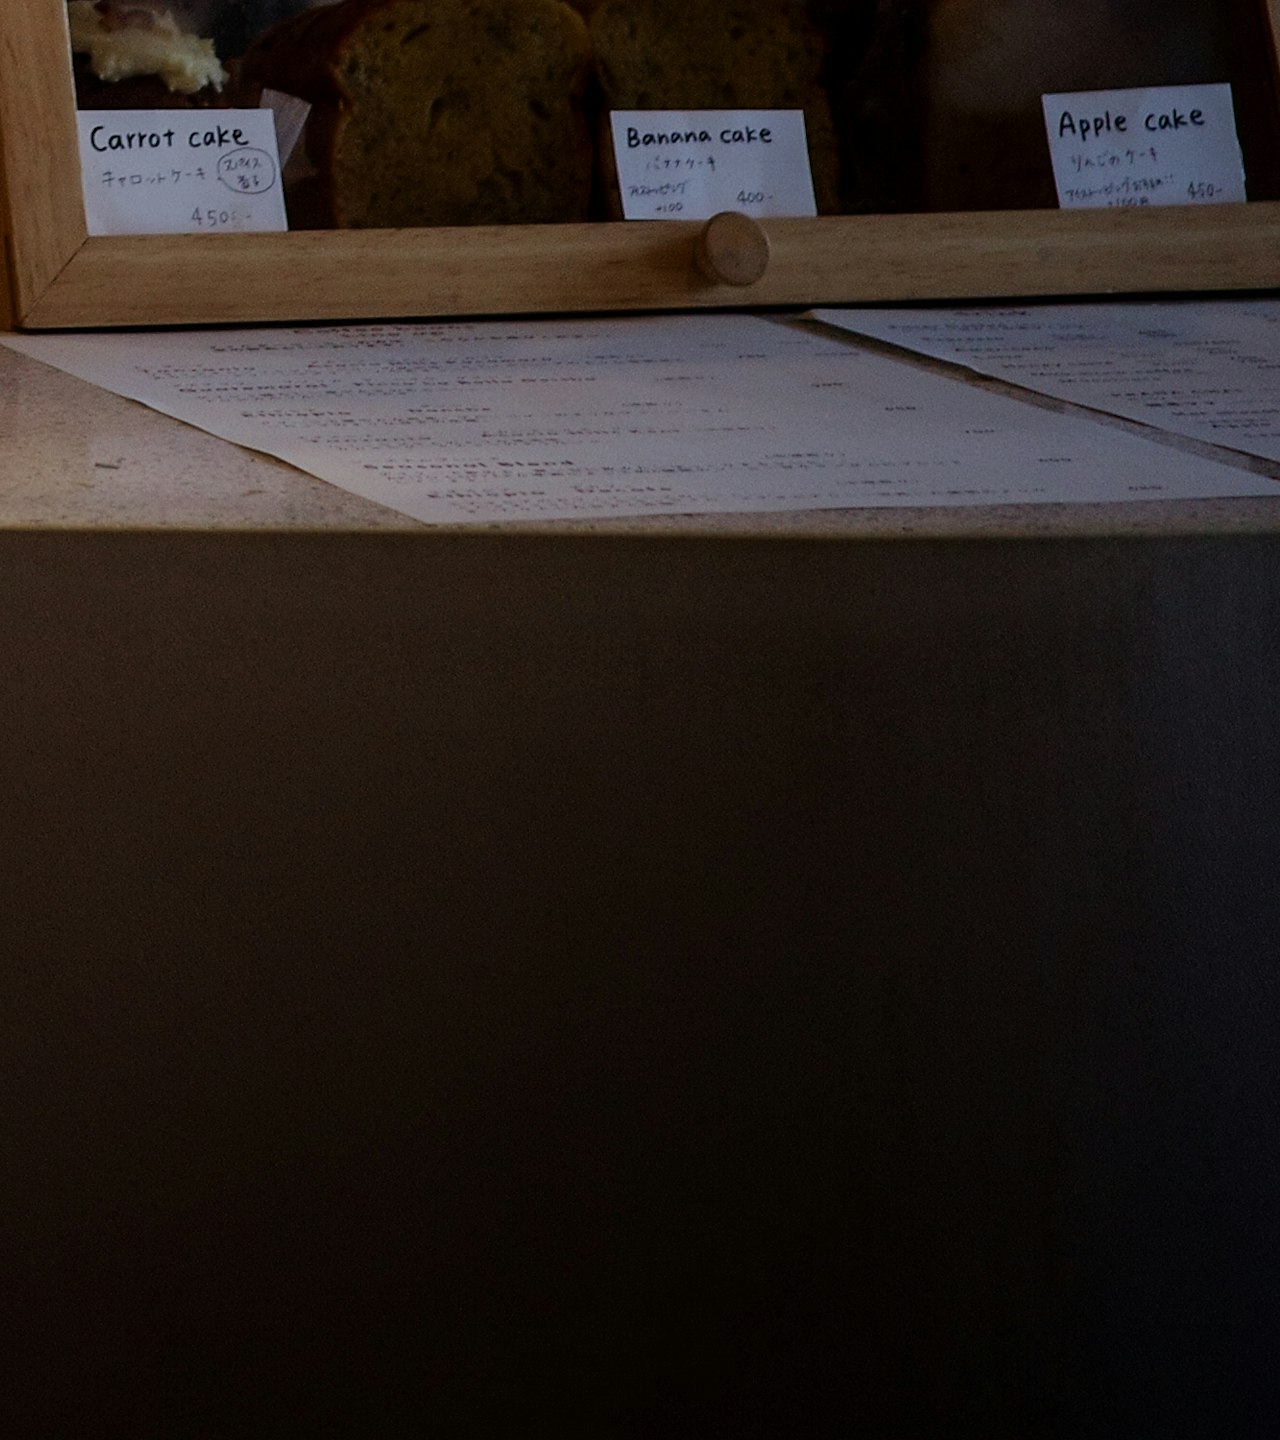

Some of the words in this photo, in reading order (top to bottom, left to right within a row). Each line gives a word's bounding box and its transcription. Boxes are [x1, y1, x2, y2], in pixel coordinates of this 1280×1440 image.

[627, 127, 711, 148] Banana
[720, 126, 773, 144] cake
[1059, 111, 1128, 141] Apple
[1145, 108, 1205, 130] cake
[91, 126, 175, 152] Carrot
[190, 126, 249, 149] cake
